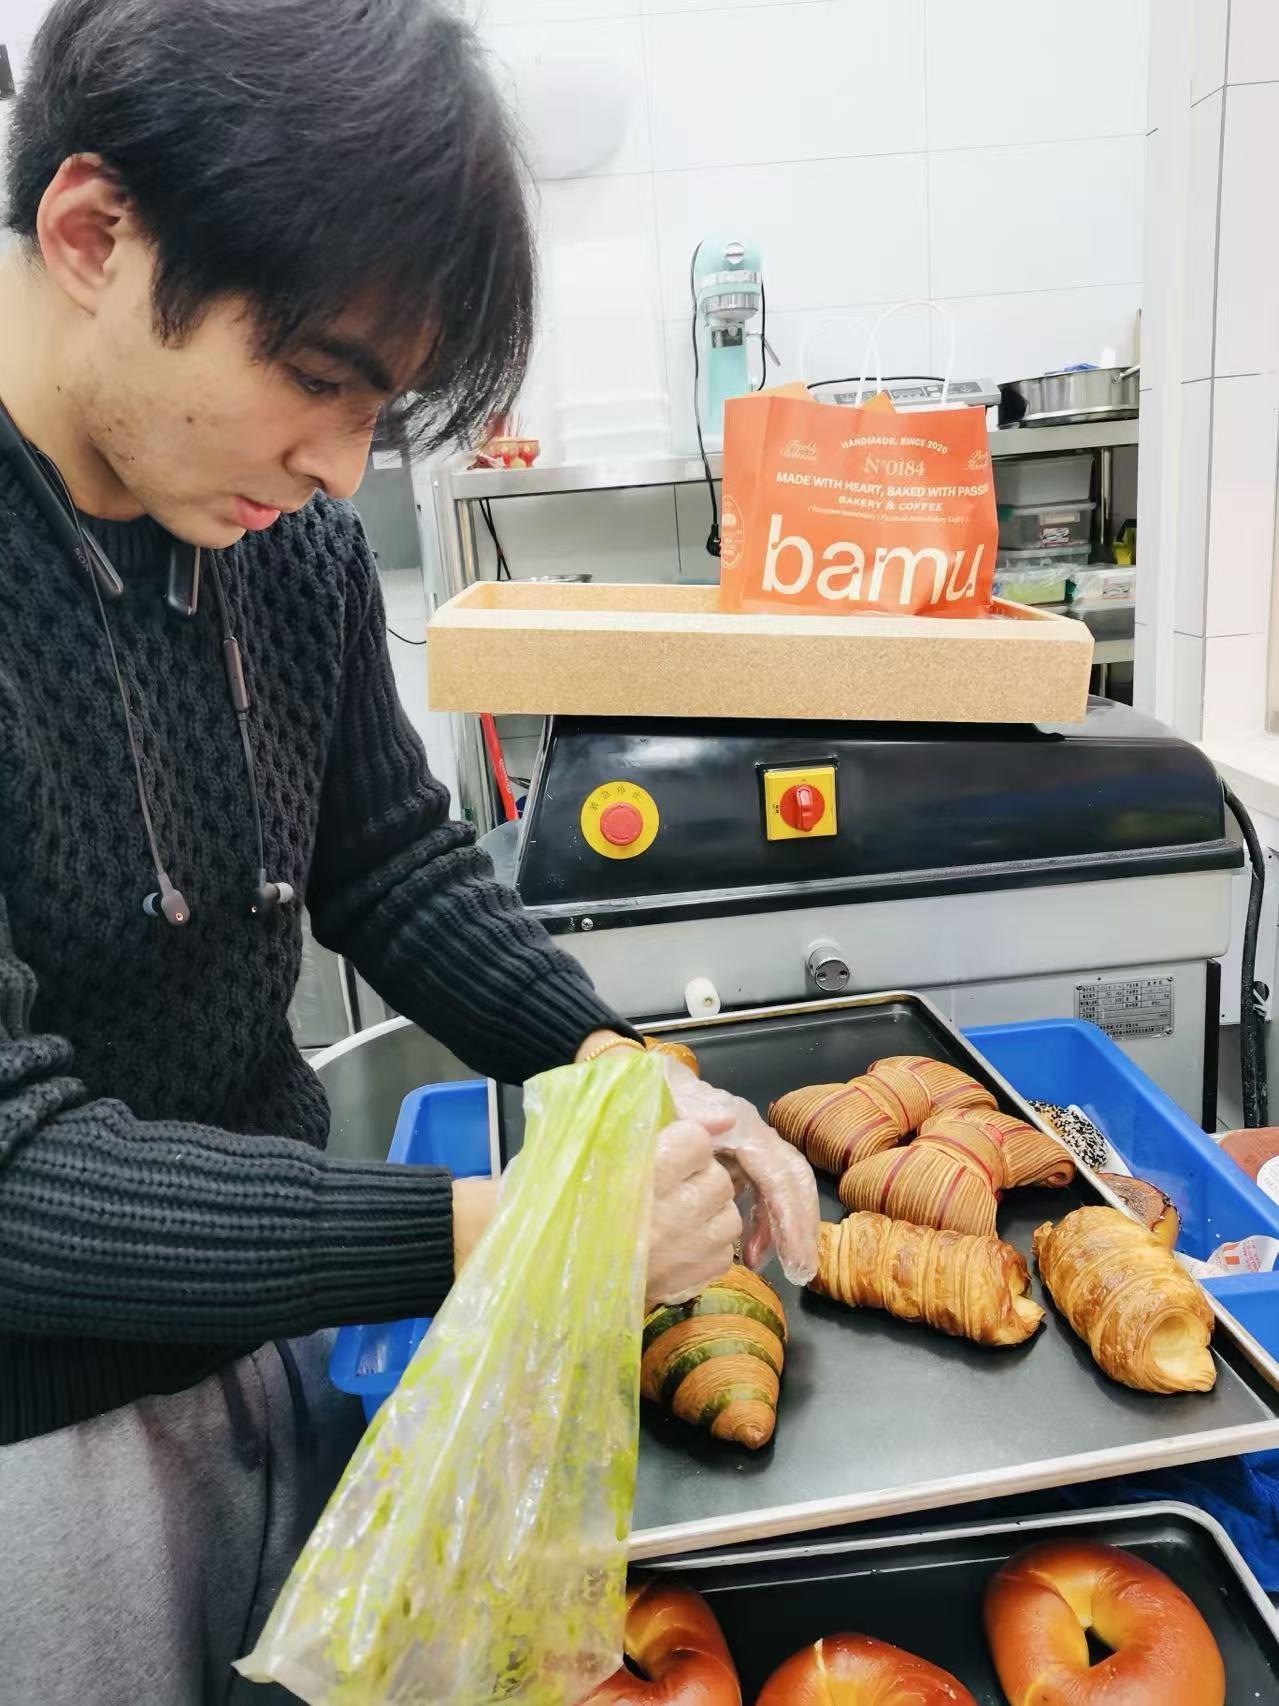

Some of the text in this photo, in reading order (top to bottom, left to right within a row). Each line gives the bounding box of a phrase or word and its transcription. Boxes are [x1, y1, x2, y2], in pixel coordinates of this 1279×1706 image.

[841, 436, 949, 454] HANDMADE, SINCE 2020
[776, 471, 811, 487] MADE
[813, 475, 843, 490] WITH
[844, 480, 886, 498] HEART,
[886, 484, 926, 497] BAKED
[928, 485, 956, 497] WITH
[837, 495, 943, 512] BAKERY & COFFEE
[762, 513, 985, 605] bamu
